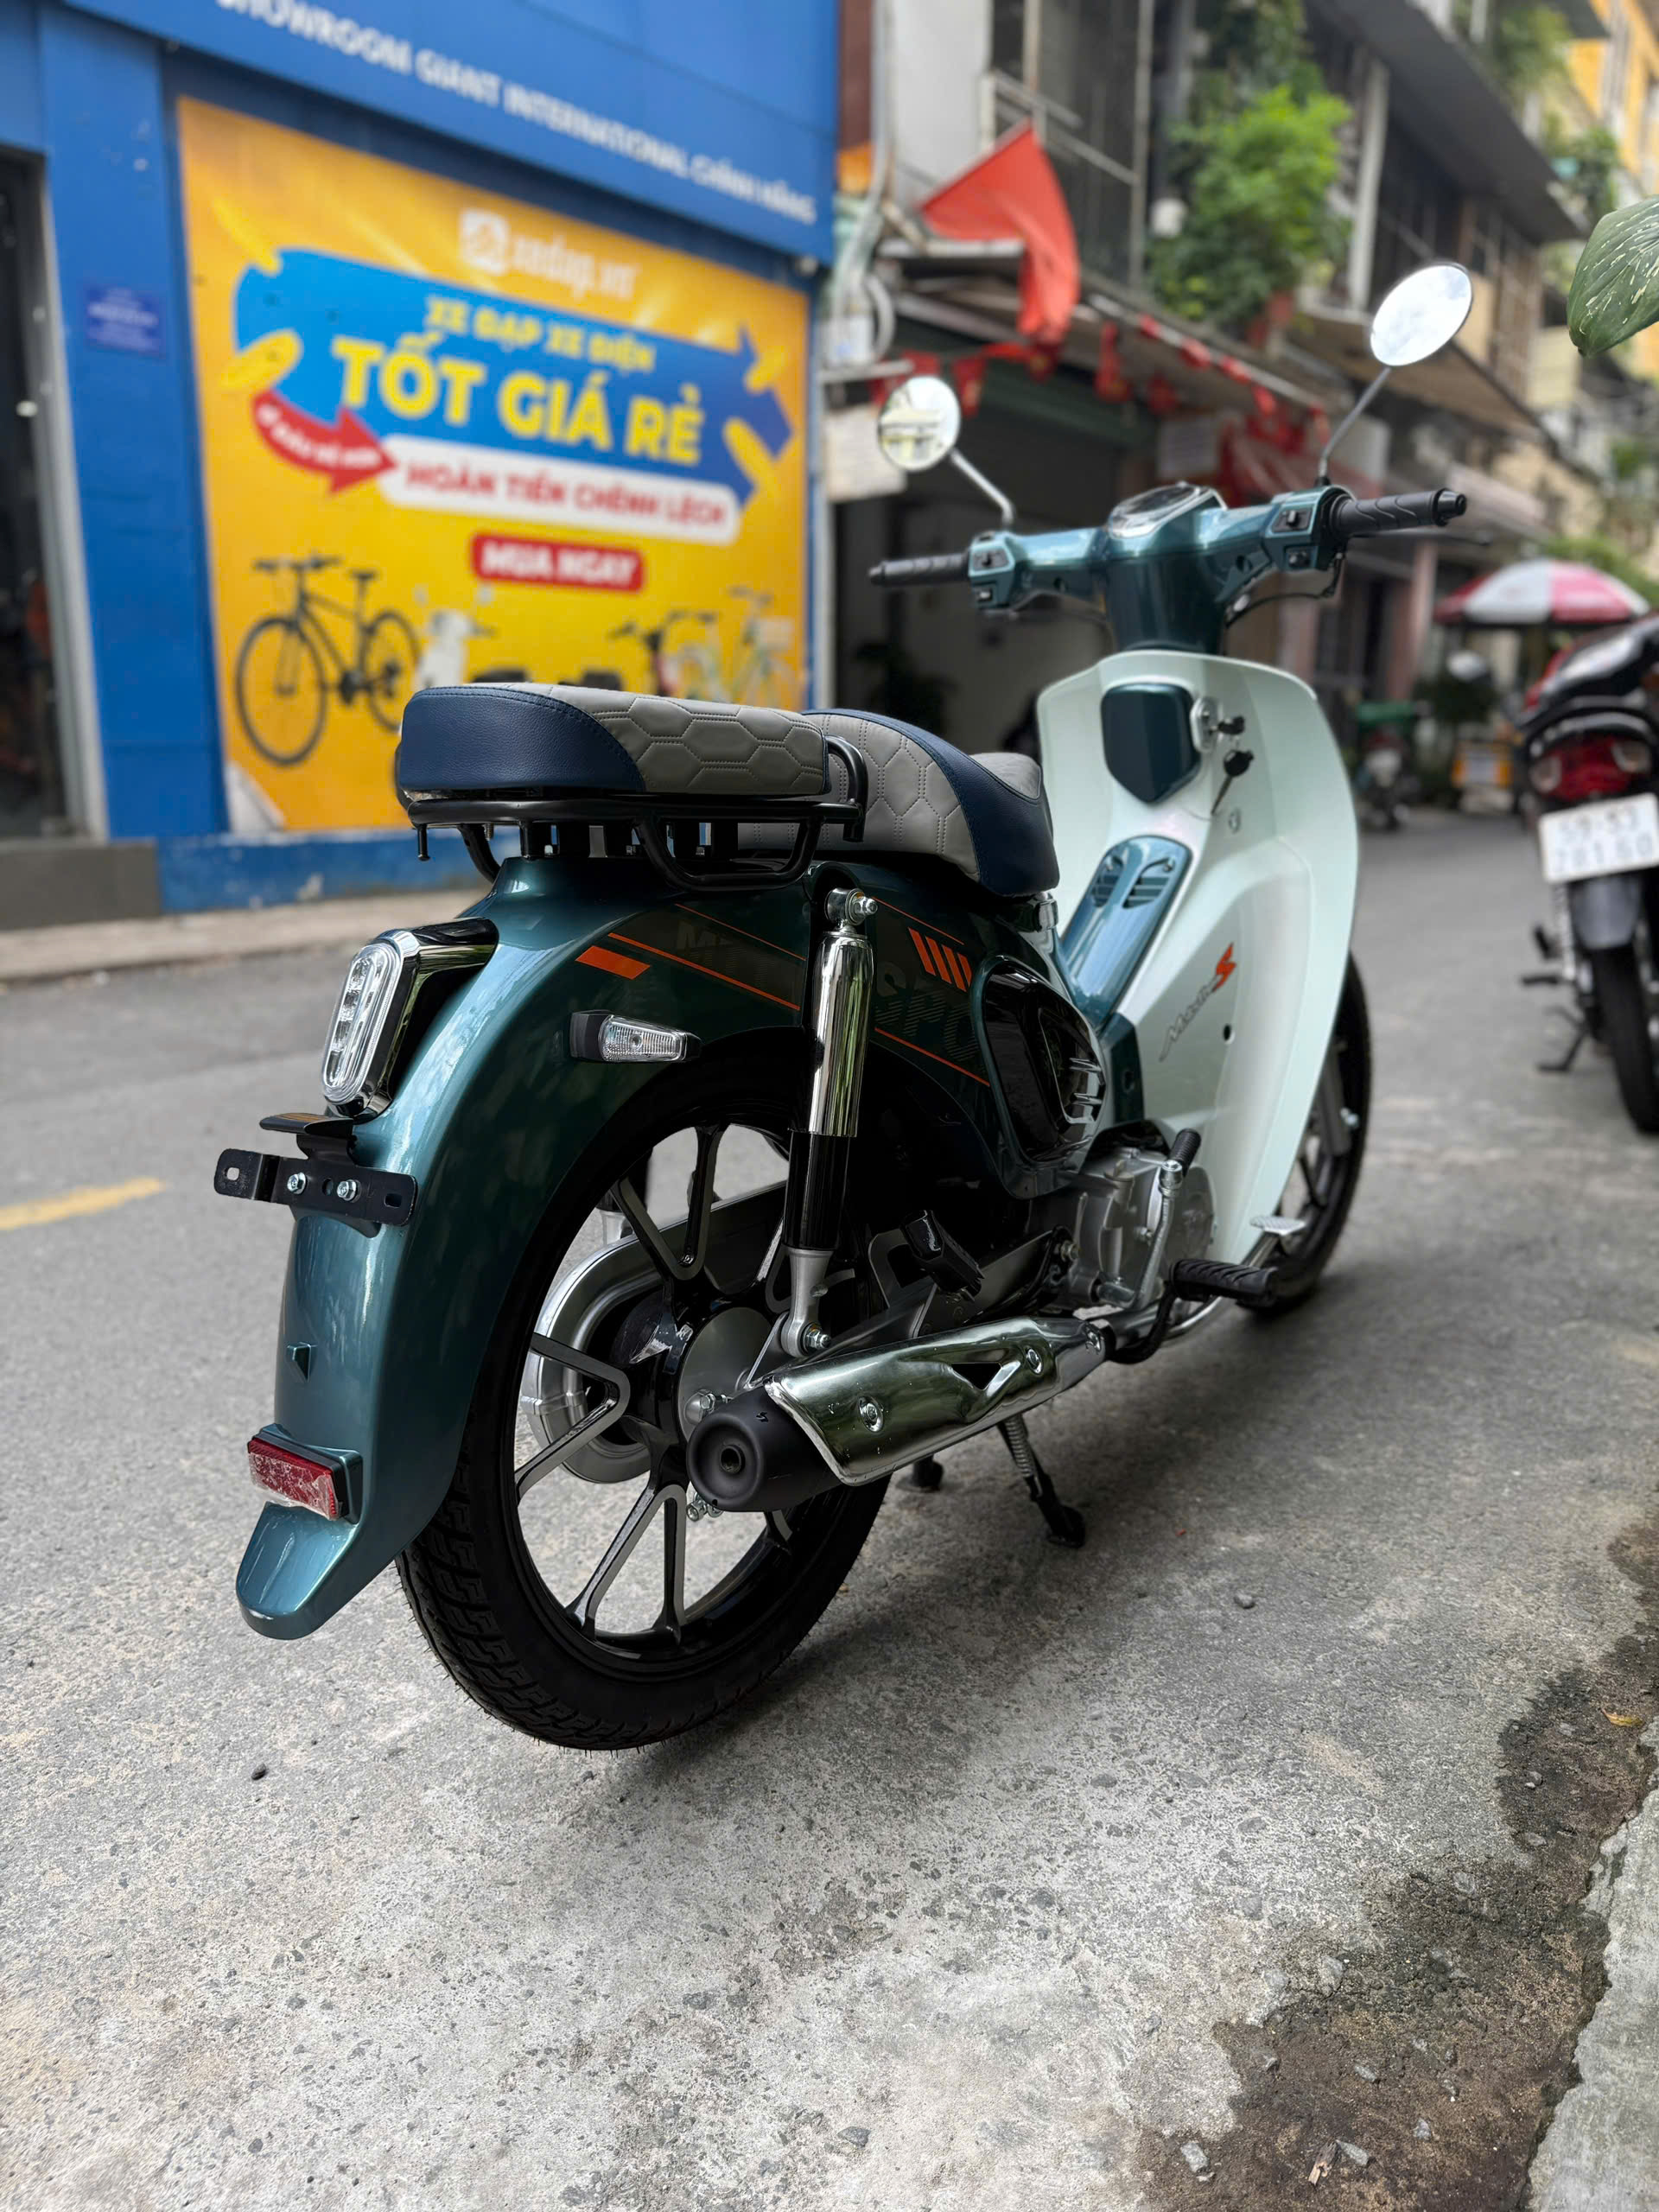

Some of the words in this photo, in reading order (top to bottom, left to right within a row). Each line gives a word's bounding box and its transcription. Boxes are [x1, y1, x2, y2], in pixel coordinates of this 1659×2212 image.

[216, 0, 413, 75] HOWROOM
[415, 48, 501, 108] GIANT
[504, 83, 689, 179] INTERNATIONAL
[425, 294, 471, 336] XE
[543, 322, 585, 358] XE
[332, 330, 487, 426] TỐT
[497, 370, 613, 452] GIÁ
[624, 383, 704, 467] RẺ
[480, 538, 554, 577] MUA
[556, 546, 639, 588] NGAY
